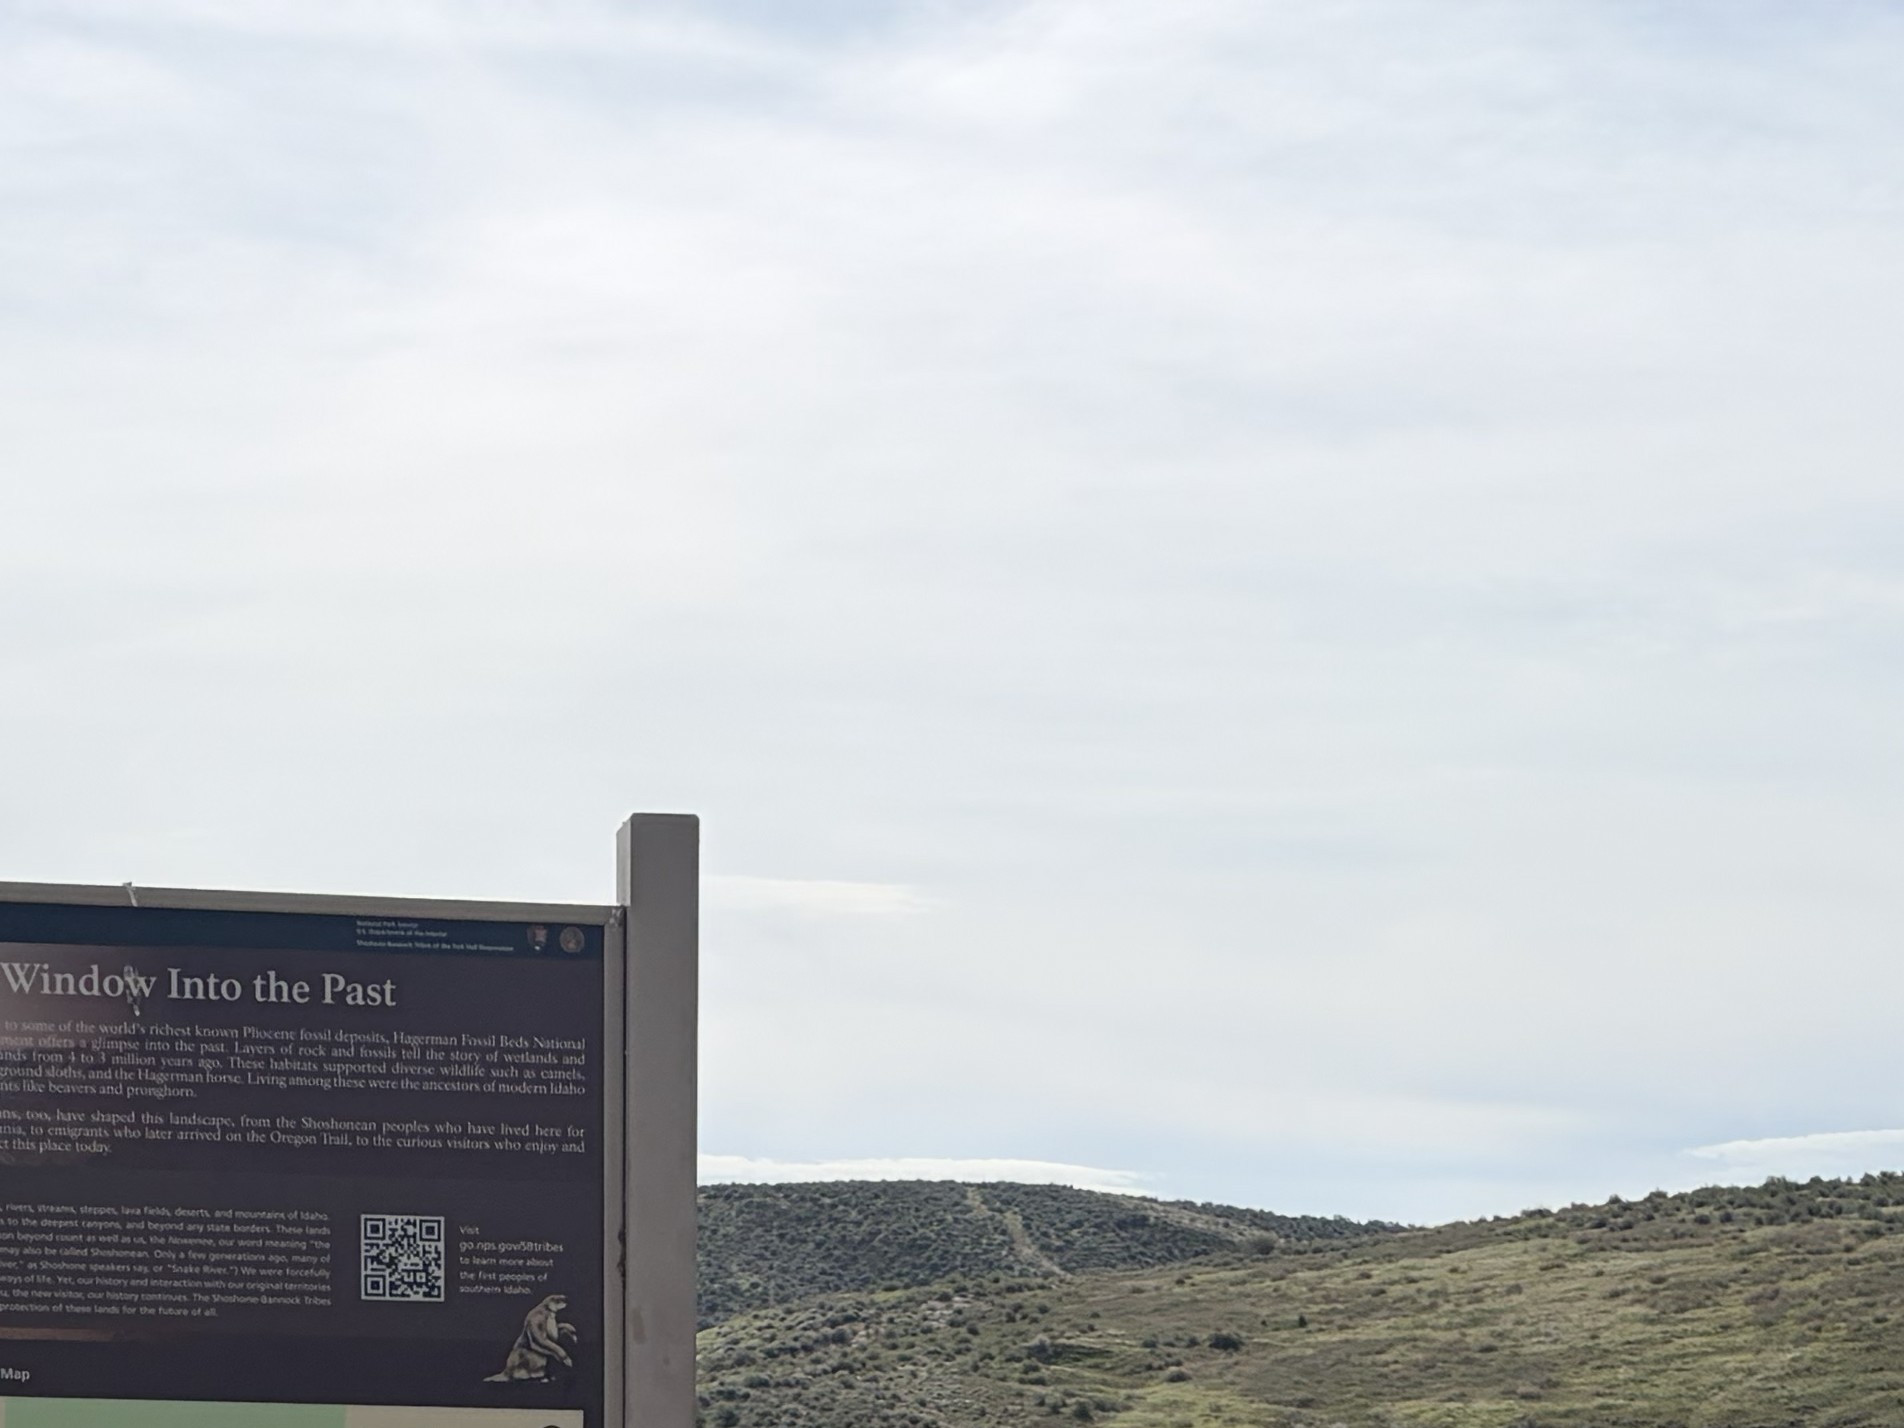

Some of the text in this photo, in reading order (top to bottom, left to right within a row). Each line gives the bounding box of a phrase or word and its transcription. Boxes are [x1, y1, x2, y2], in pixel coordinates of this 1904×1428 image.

[0, 962, 156, 997] Window
[168, 968, 242, 1001] Into
[253, 970, 310, 1004] the
[321, 973, 396, 1007] Past
[5, 1019, 17, 1032] to
[22, 1023, 54, 1033] some
[58, 1020, 71, 1034] of
[76, 1021, 94, 1035] the
[150, 1023, 191, 1038] richest
[194, 1025, 238, 1039] known
[243, 1026, 294, 1041] Pliocene
[300, 1028, 331, 1042] fossil
[393, 1031, 457, 1050] Hagerman
[461, 1033, 496, 1047] Fossil
[500, 1034, 529, 1048] Beds
[532, 1035, 586, 1050] National
[22, 1079, 45, 1093] like
[48, 1080, 96, 1094] beavers
[99, 1081, 123, 1095] and
[126, 1082, 197, 1101] pronghorn.
[26, 1107, 51, 1125] too,
[56, 1108, 84, 1122] have
[90, 1109, 135, 1128] shaped
[140, 1111, 164, 1124] this
[169, 1112, 234, 1131] landscape,
[240, 1114, 270, 1128] from
[276, 1115, 296, 1128] the
[382, 1118, 430, 1136] peoples
[434, 1119, 462, 1133] who
[467, 1120, 495, 1134] have
[500, 1121, 530, 1135] lived
[534, 1122, 562, 1136] here
[567, 1123, 586, 1137] for
[12, 1137, 36, 1150] this
[39, 1137, 72, 1155] place
[75, 1138, 112, 1156] today.
[459, 1224, 480, 1234] Visit
[0, 1367, 30, 1384] Map
